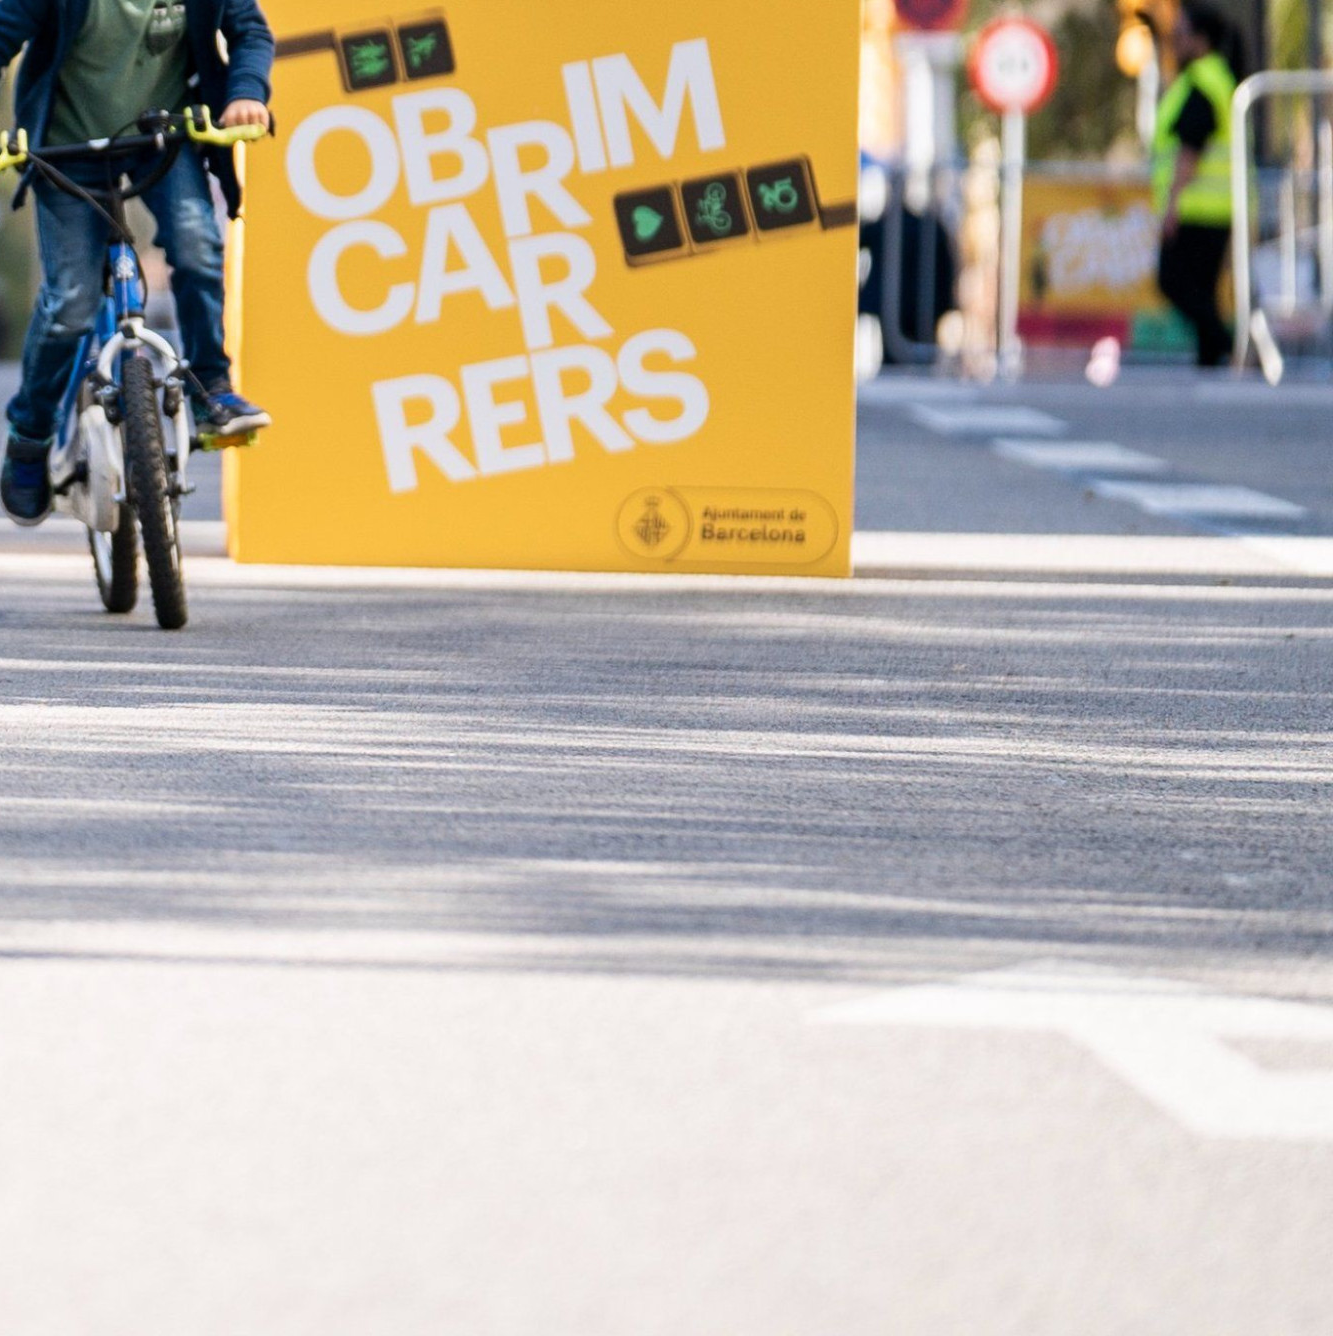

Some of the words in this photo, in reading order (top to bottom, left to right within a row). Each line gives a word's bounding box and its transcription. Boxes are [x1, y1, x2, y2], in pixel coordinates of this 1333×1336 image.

[285, 37, 726, 239] OBRIM
[306, 202, 614, 350] CAR
[370, 328, 710, 495] RERS
[700, 523, 806, 543] Barcelona
[702, 505, 785, 522] Ajuntament
[789, 506, 807, 522] de
